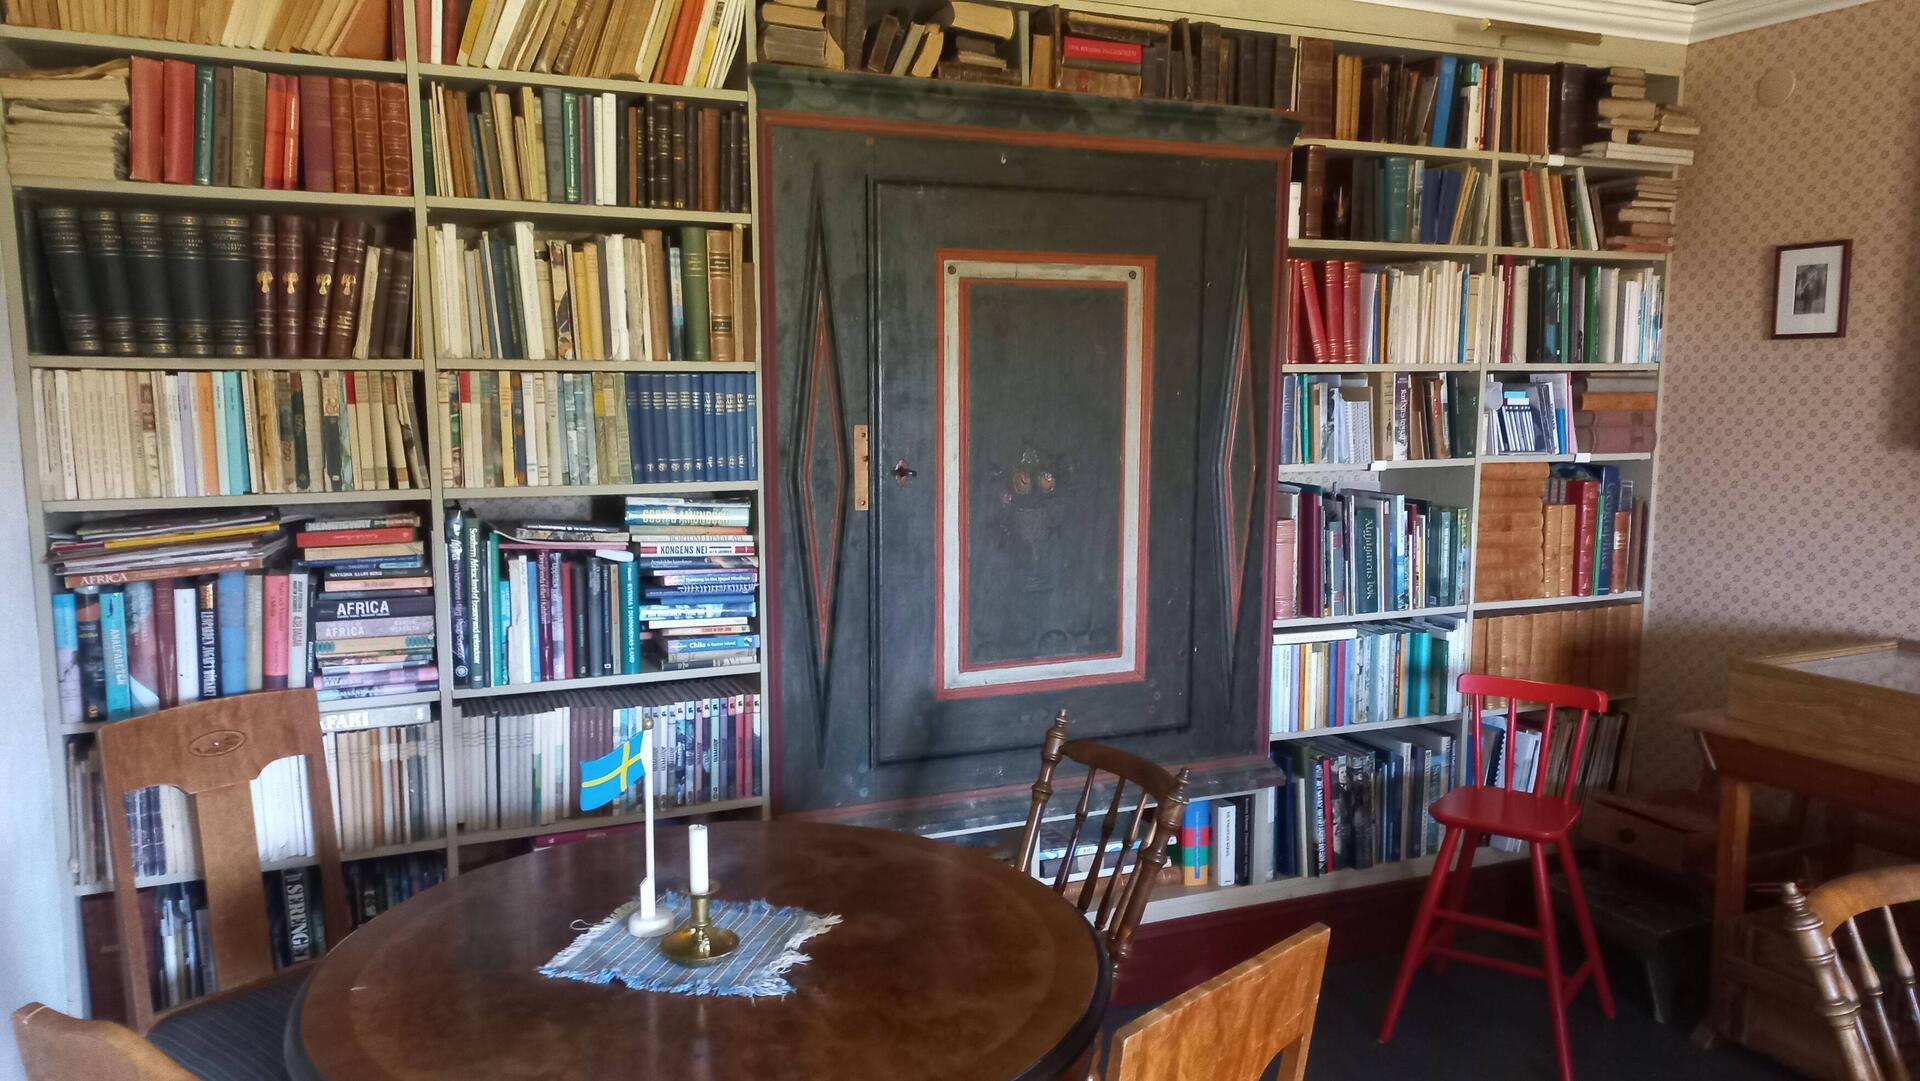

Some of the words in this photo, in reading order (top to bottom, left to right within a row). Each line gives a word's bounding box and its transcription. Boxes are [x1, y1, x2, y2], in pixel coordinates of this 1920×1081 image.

[469, 527, 478, 558] Southern
[660, 546, 694, 554] KONGENS
[696, 546, 708, 554] NEI
[80, 572, 128, 586] AFRICA
[337, 600, 390, 616] AFRICA
[200, 611, 215, 645] LEOPARDEN
[325, 626, 365, 637] AFRICA
